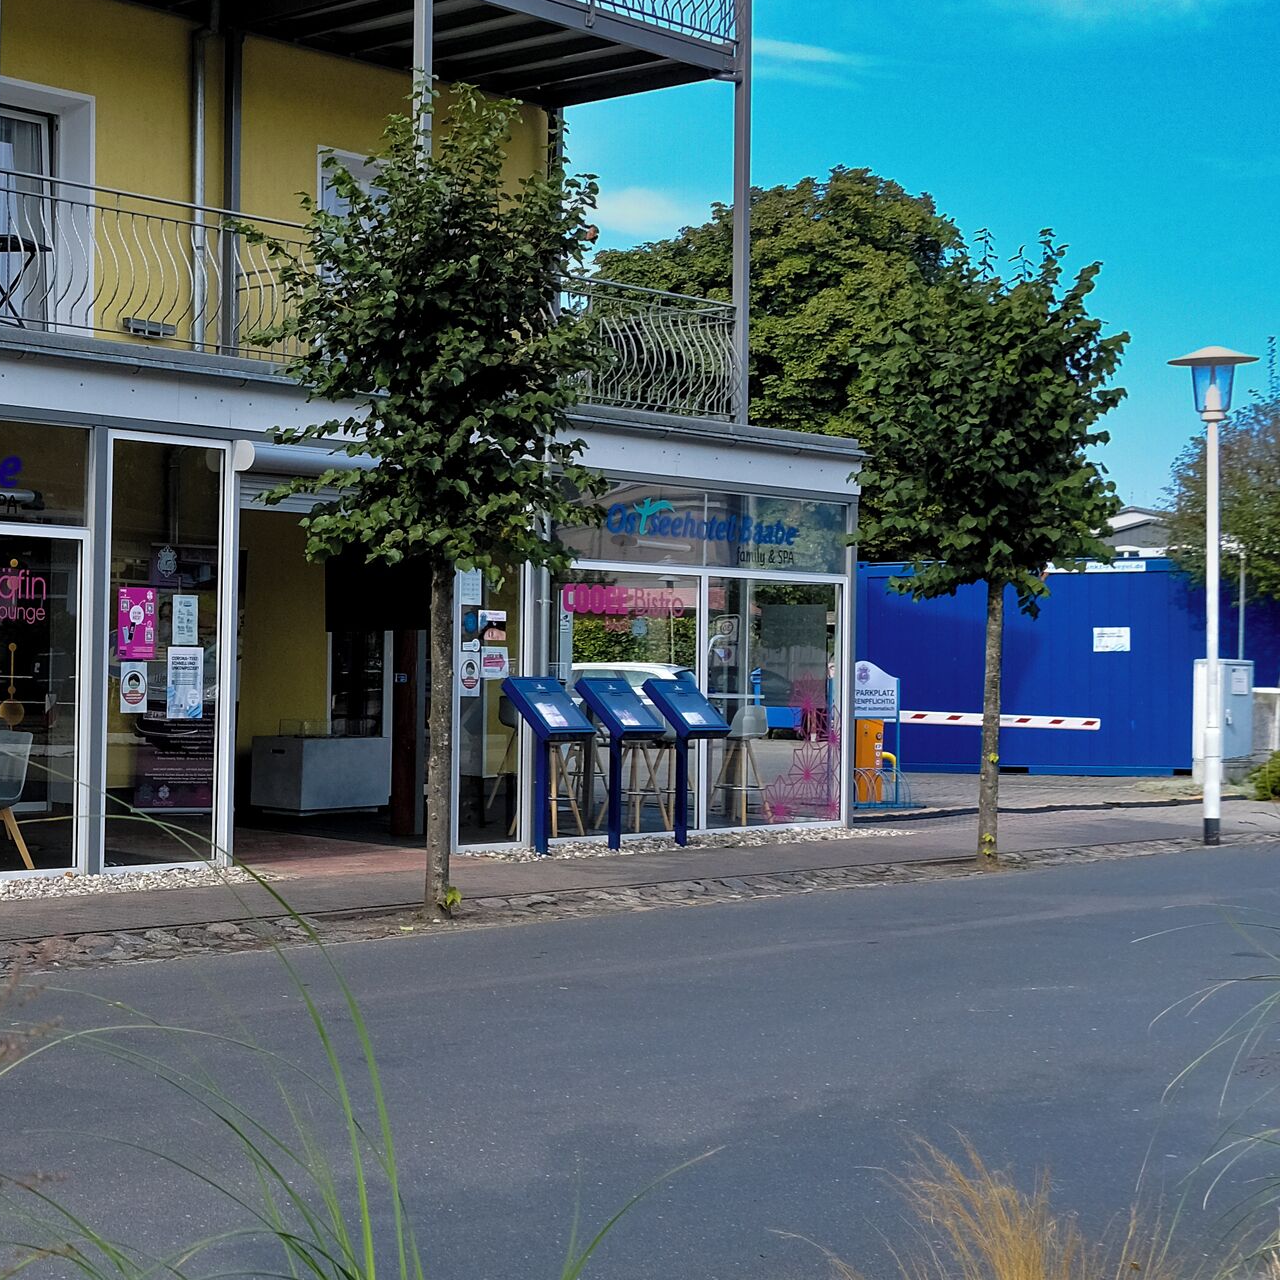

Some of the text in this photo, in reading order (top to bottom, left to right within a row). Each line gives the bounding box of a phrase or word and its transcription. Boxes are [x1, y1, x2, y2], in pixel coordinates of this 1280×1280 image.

[606, 497, 799, 546] Ostseehotel Baabe
[736, 546, 795, 567] family & SPA
[563, 583, 685, 617] COOEE Bistro
[855, 689, 895, 697] PARKPLATZ
